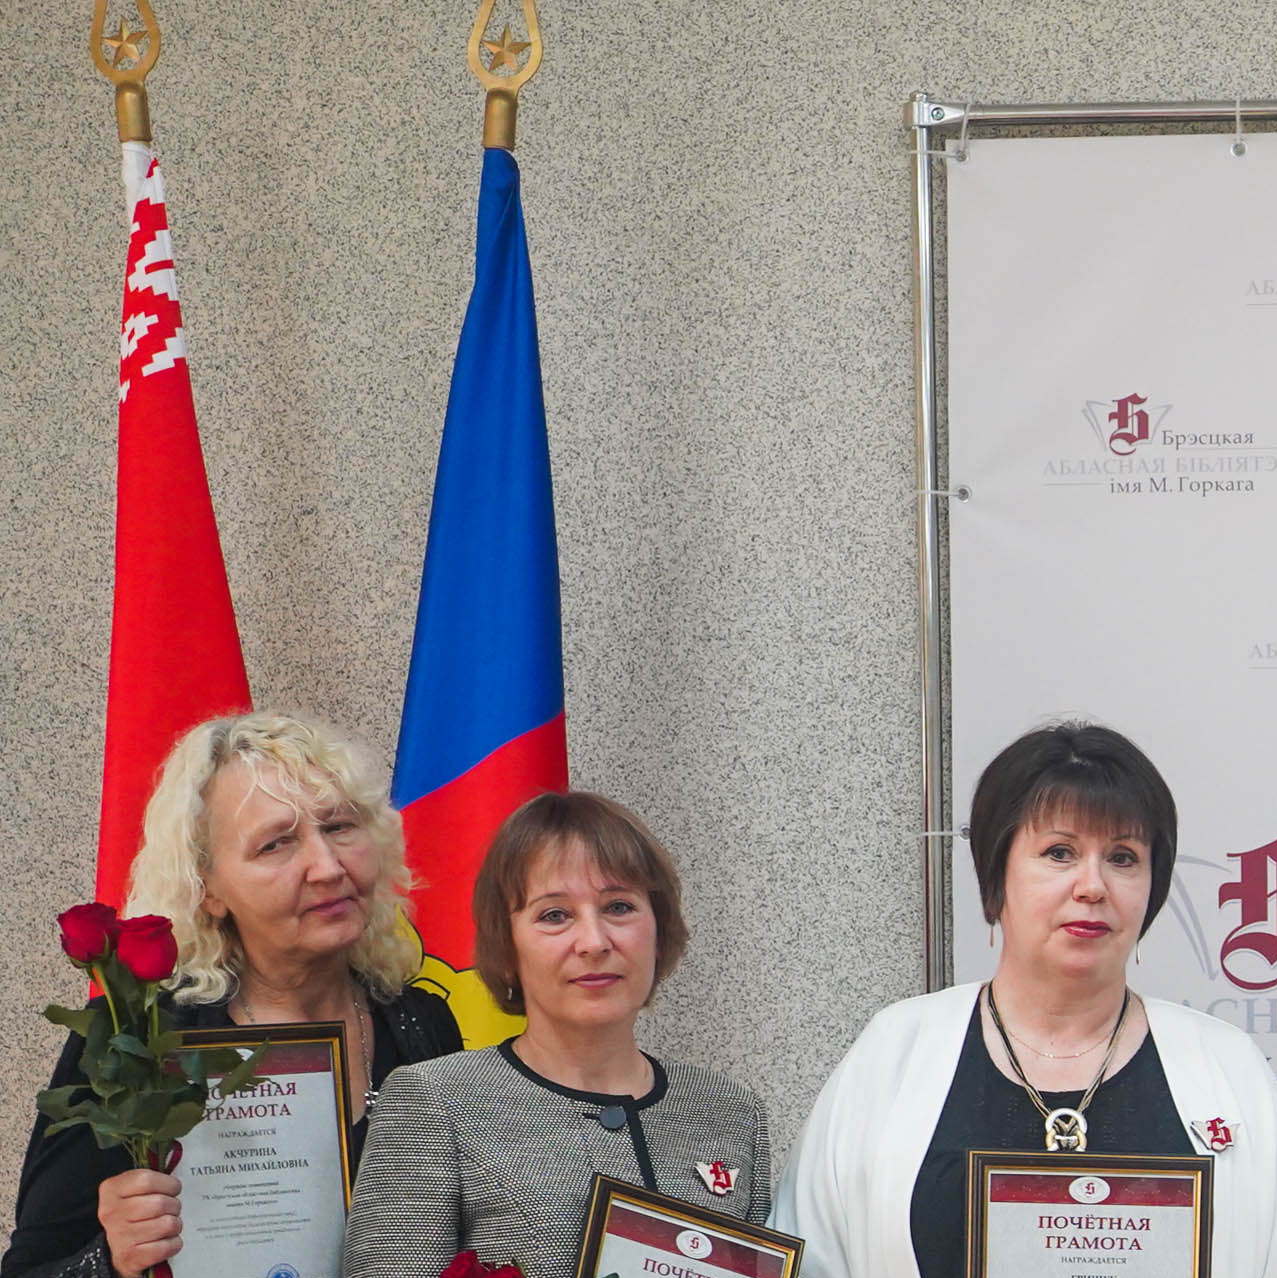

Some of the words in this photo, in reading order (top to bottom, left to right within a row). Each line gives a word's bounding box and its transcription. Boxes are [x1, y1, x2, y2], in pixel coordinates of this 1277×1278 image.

[1162, 430, 1254, 450] Брэсцкая
[1043, 458, 1166, 476] АБЛАСНАЯ
[1110, 478, 1141, 494] імя
[1179, 477, 1255, 497] Горкага
[223, 1147, 277, 1159] АКЧУРИНА
[190, 1164, 236, 1177] ТАТЬЯНА
[1038, 1214, 1151, 1231] ПОЧЁТНАЯ
[1045, 1236, 1143, 1251] ГРАМОТА
